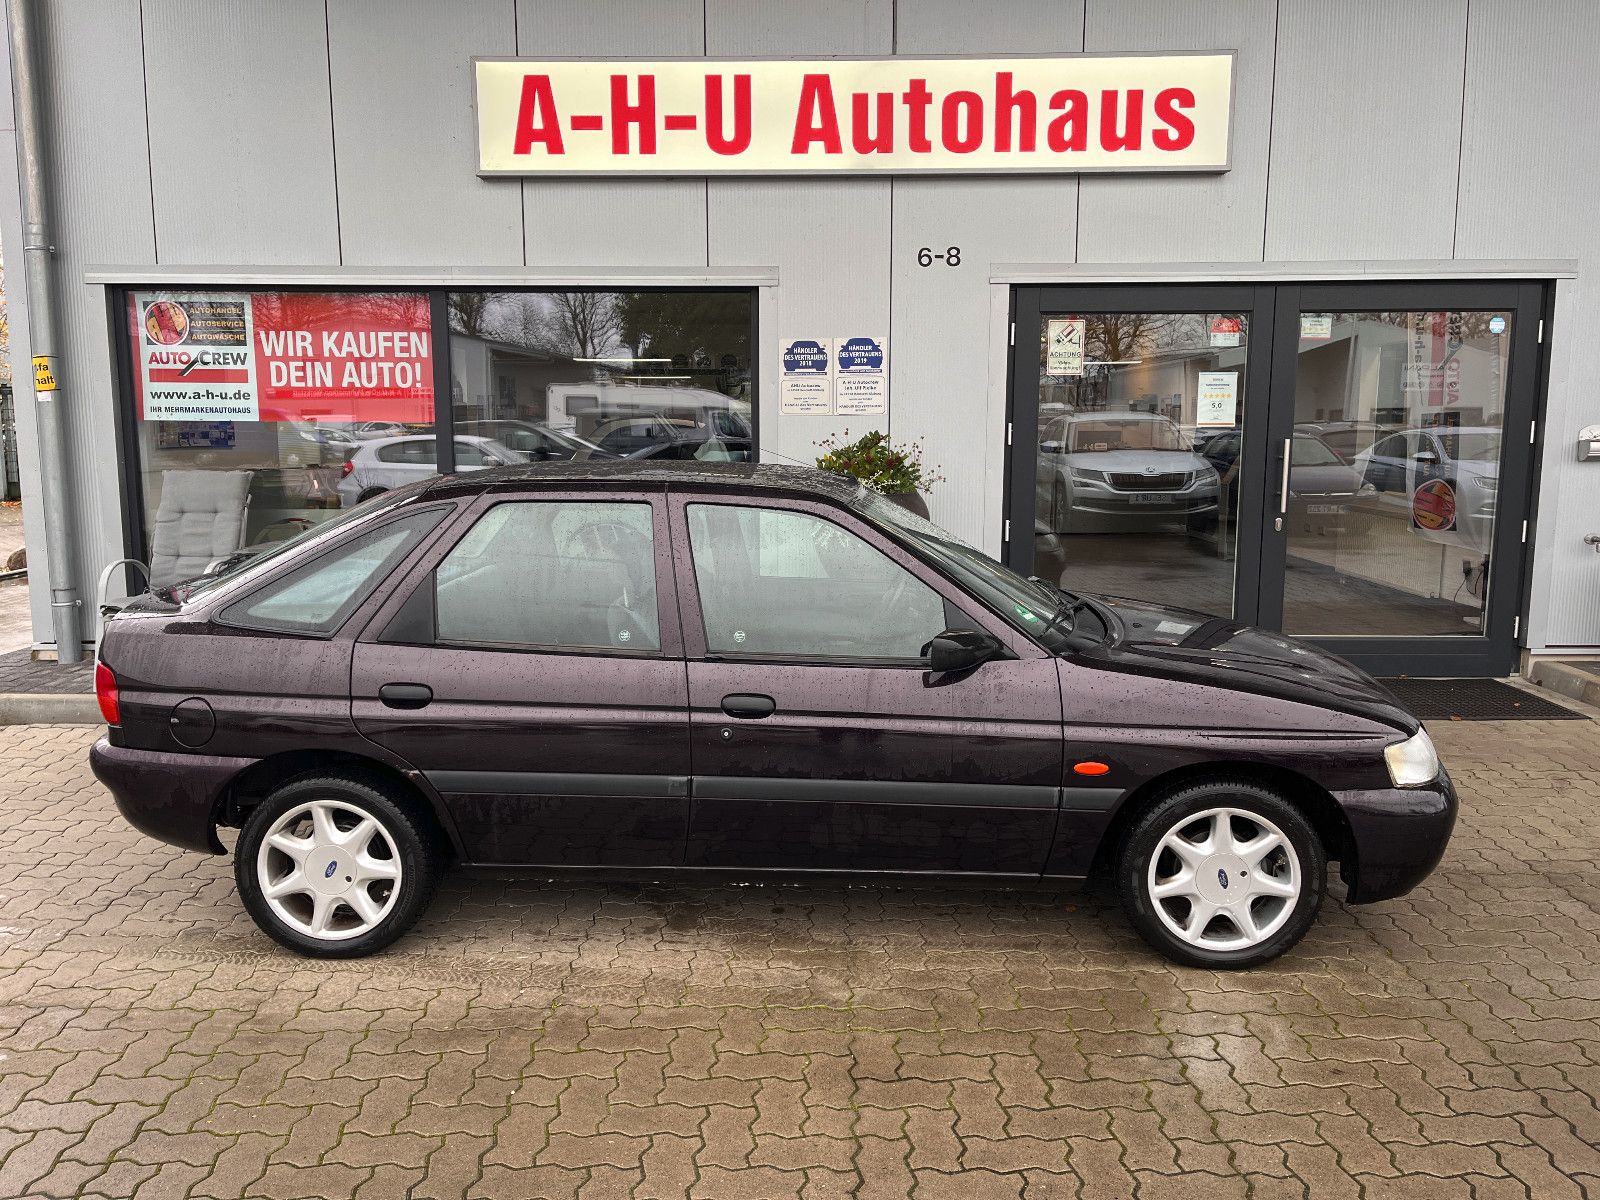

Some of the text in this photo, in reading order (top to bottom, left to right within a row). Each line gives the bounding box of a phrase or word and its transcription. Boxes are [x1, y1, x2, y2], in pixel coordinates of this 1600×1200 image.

[513, 71, 1196, 156] A-H-U Autohaus
[917, 246, 961, 268] 6-8
[189, 306, 242, 314] AUTOHANDEL
[259, 330, 428, 358] WIR KAUFEN
[148, 350, 248, 366] AUTO CREW
[269, 361, 423, 388] DEIN AUTO!
[149, 389, 251, 400] www.a-h-u.de
[164, 406, 251, 414] MEHRMARKENAUTOHAUS
